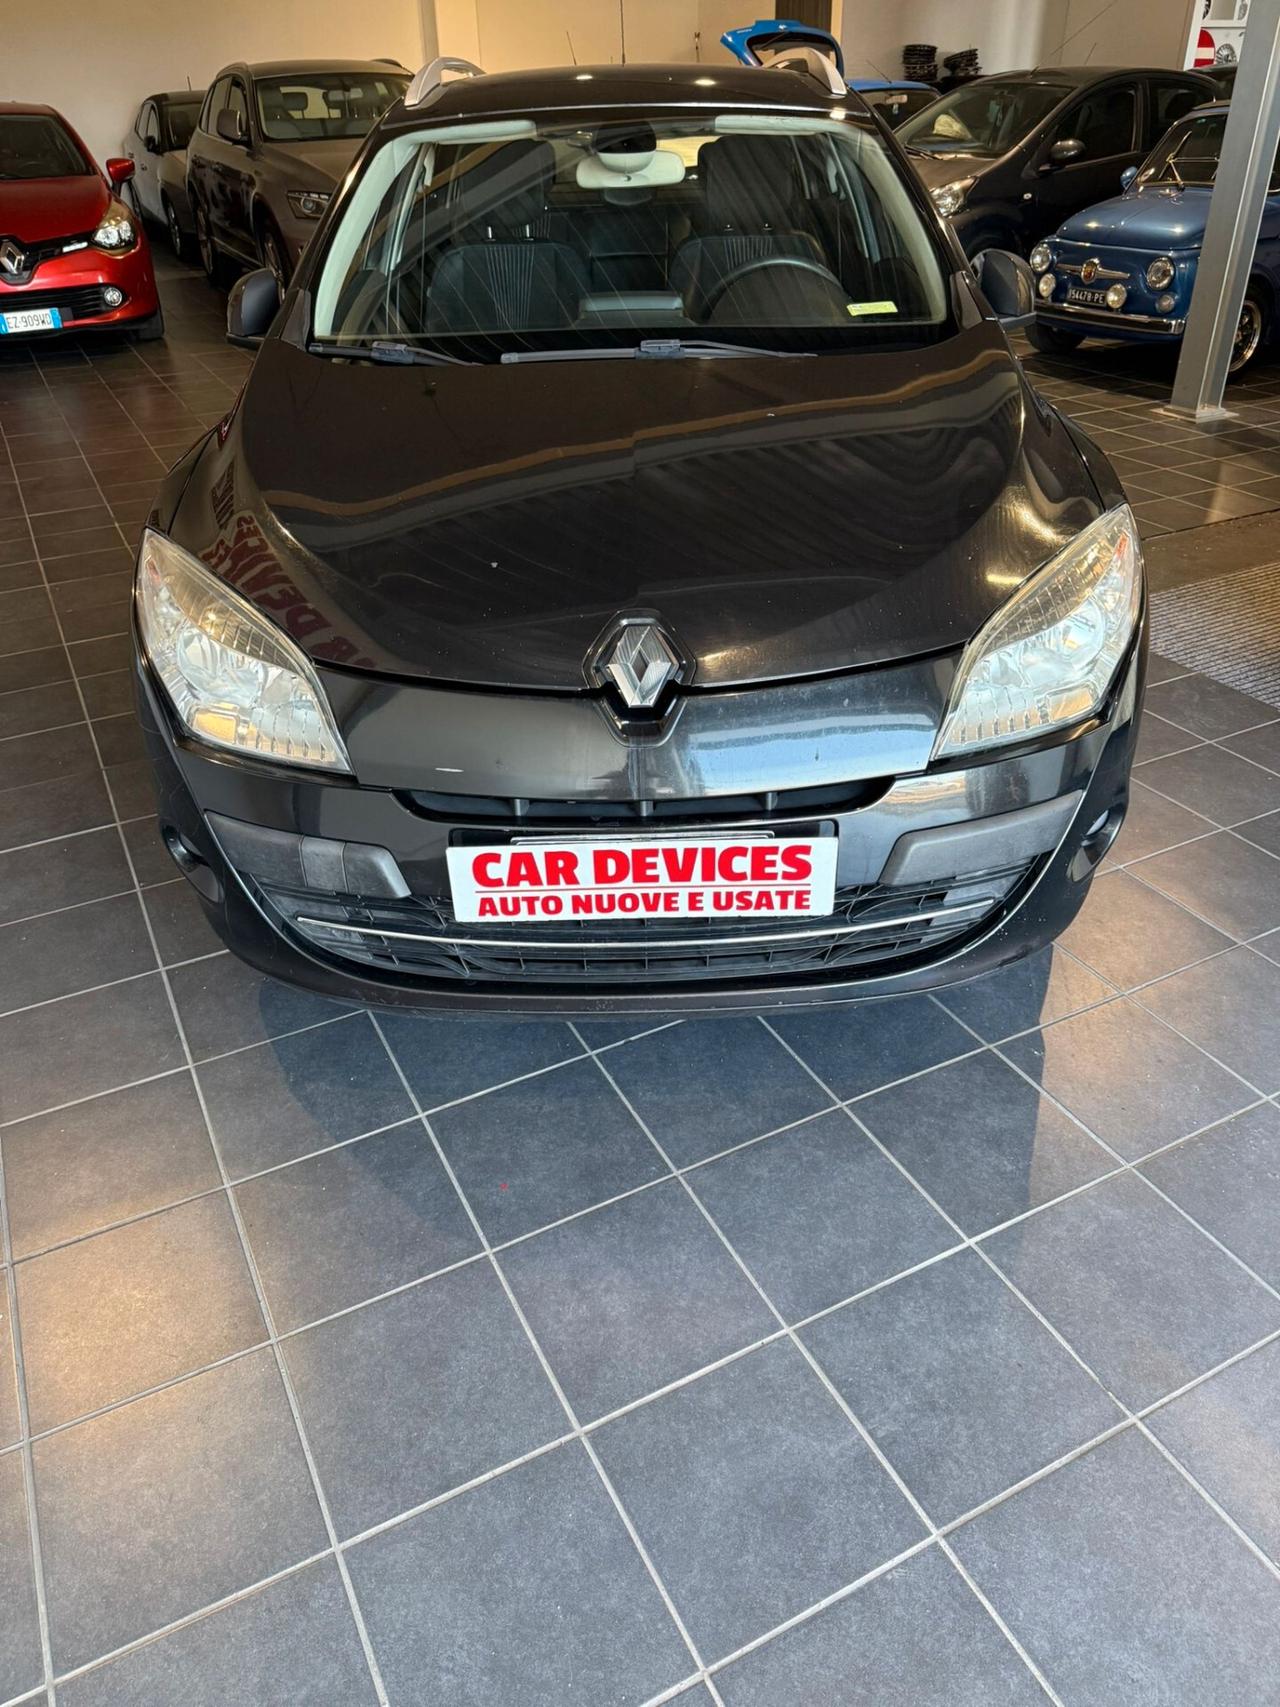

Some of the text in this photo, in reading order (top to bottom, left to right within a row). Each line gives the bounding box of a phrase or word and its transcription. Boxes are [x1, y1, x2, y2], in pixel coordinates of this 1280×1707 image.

[472, 845, 812, 888] CAR DEVICES
[478, 889, 811, 917] AUTO NUOVE E USATE
